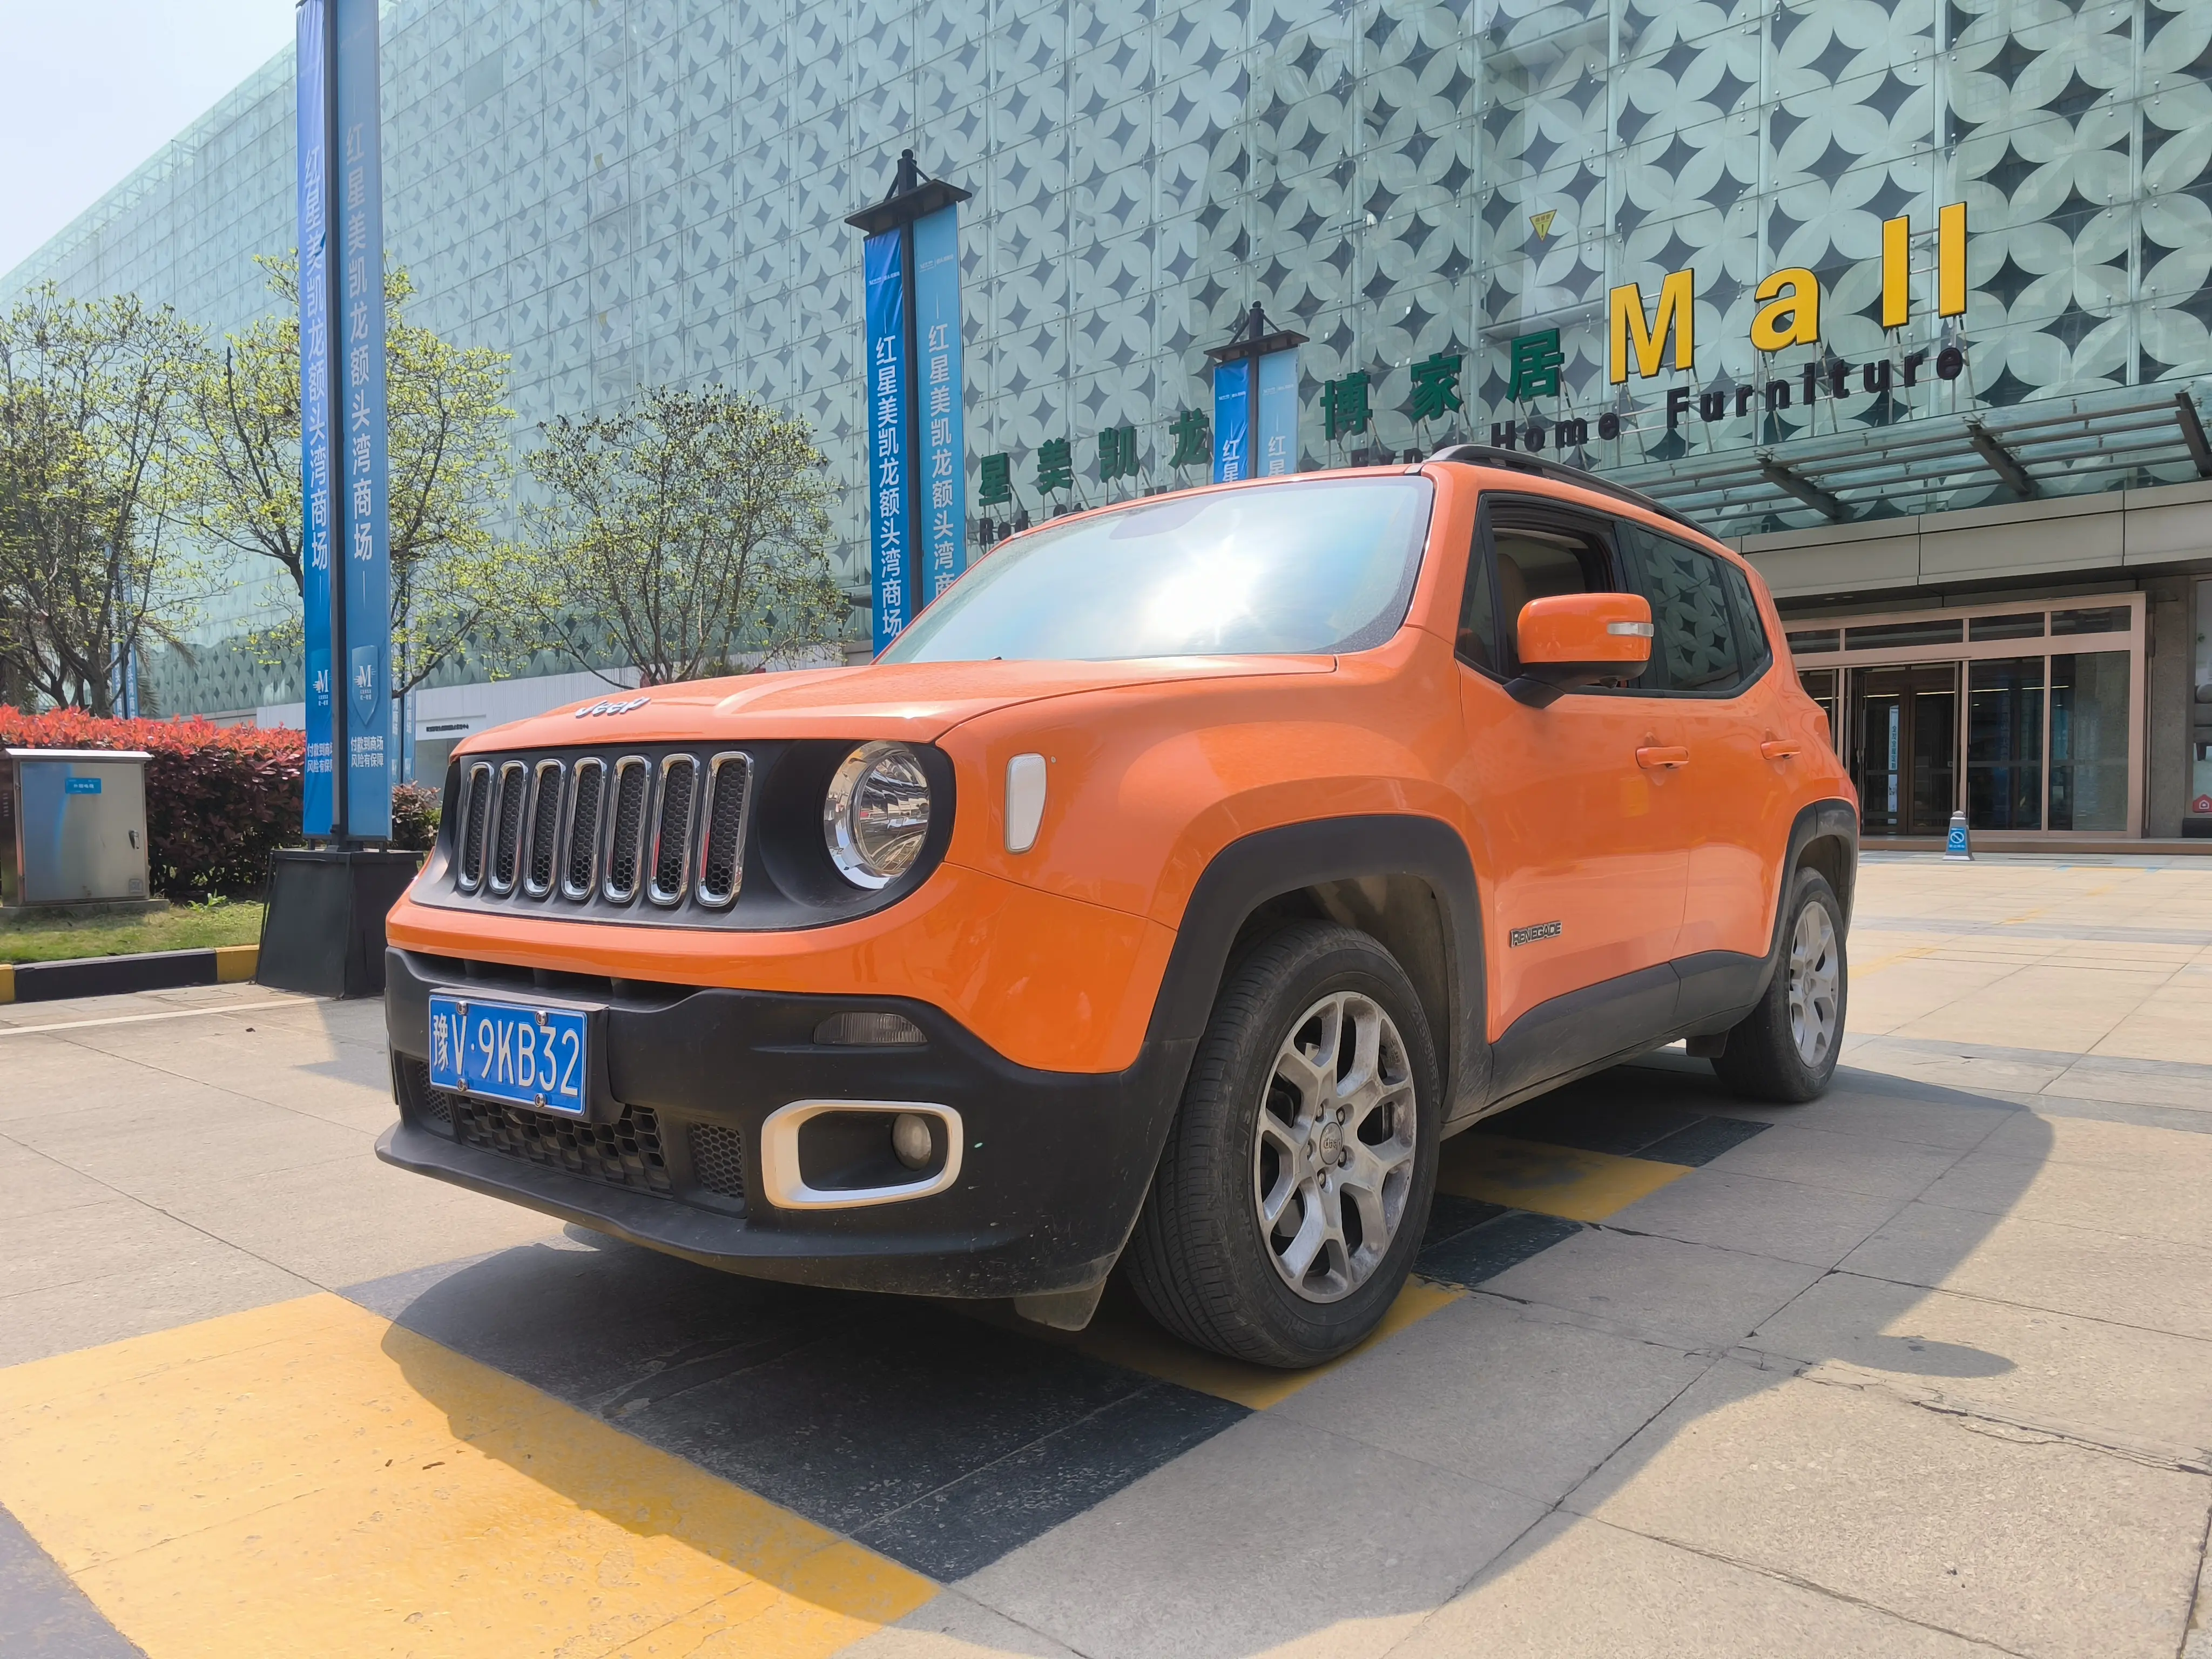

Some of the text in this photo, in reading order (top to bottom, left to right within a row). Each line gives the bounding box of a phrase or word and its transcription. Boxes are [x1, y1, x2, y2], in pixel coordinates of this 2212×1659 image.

[346, 122, 373, 562] 红星美凯龙额头湾商场
[1609, 201, 1967, 385] Mall
[305, 144, 328, 570] 红星美凯龙额头湾商场
[1491, 412, 1620, 453] Home
[1667, 347, 1964, 430] Furniture
[876, 335, 902, 638] 红星美凯龙额头湾商场
[350, 736, 383, 752] 付款到商场
[351, 753, 384, 767] 风险有保障
[575, 696, 651, 719] Jeep
[1511, 921, 1562, 947] RENEGADE
